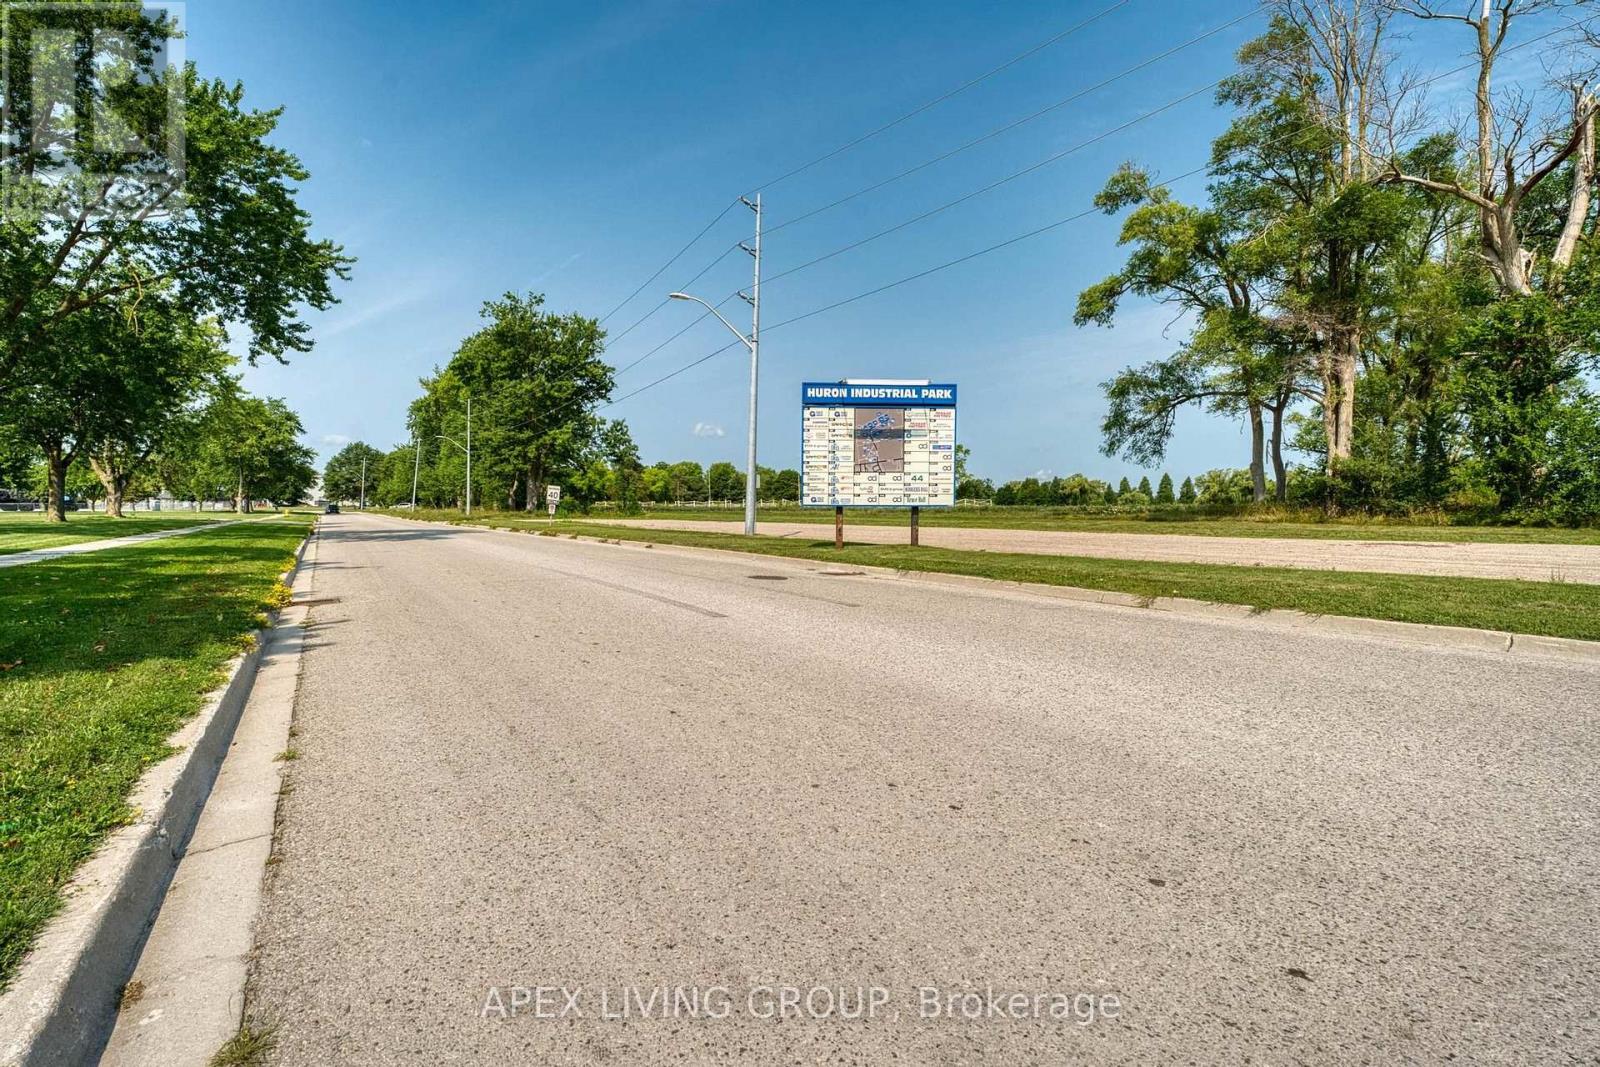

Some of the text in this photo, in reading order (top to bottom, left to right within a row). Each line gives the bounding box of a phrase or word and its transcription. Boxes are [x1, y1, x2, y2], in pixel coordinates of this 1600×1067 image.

[807, 387, 952, 399] HURON INDUSTRIAL PARK
[548, 491, 559, 499] 40
